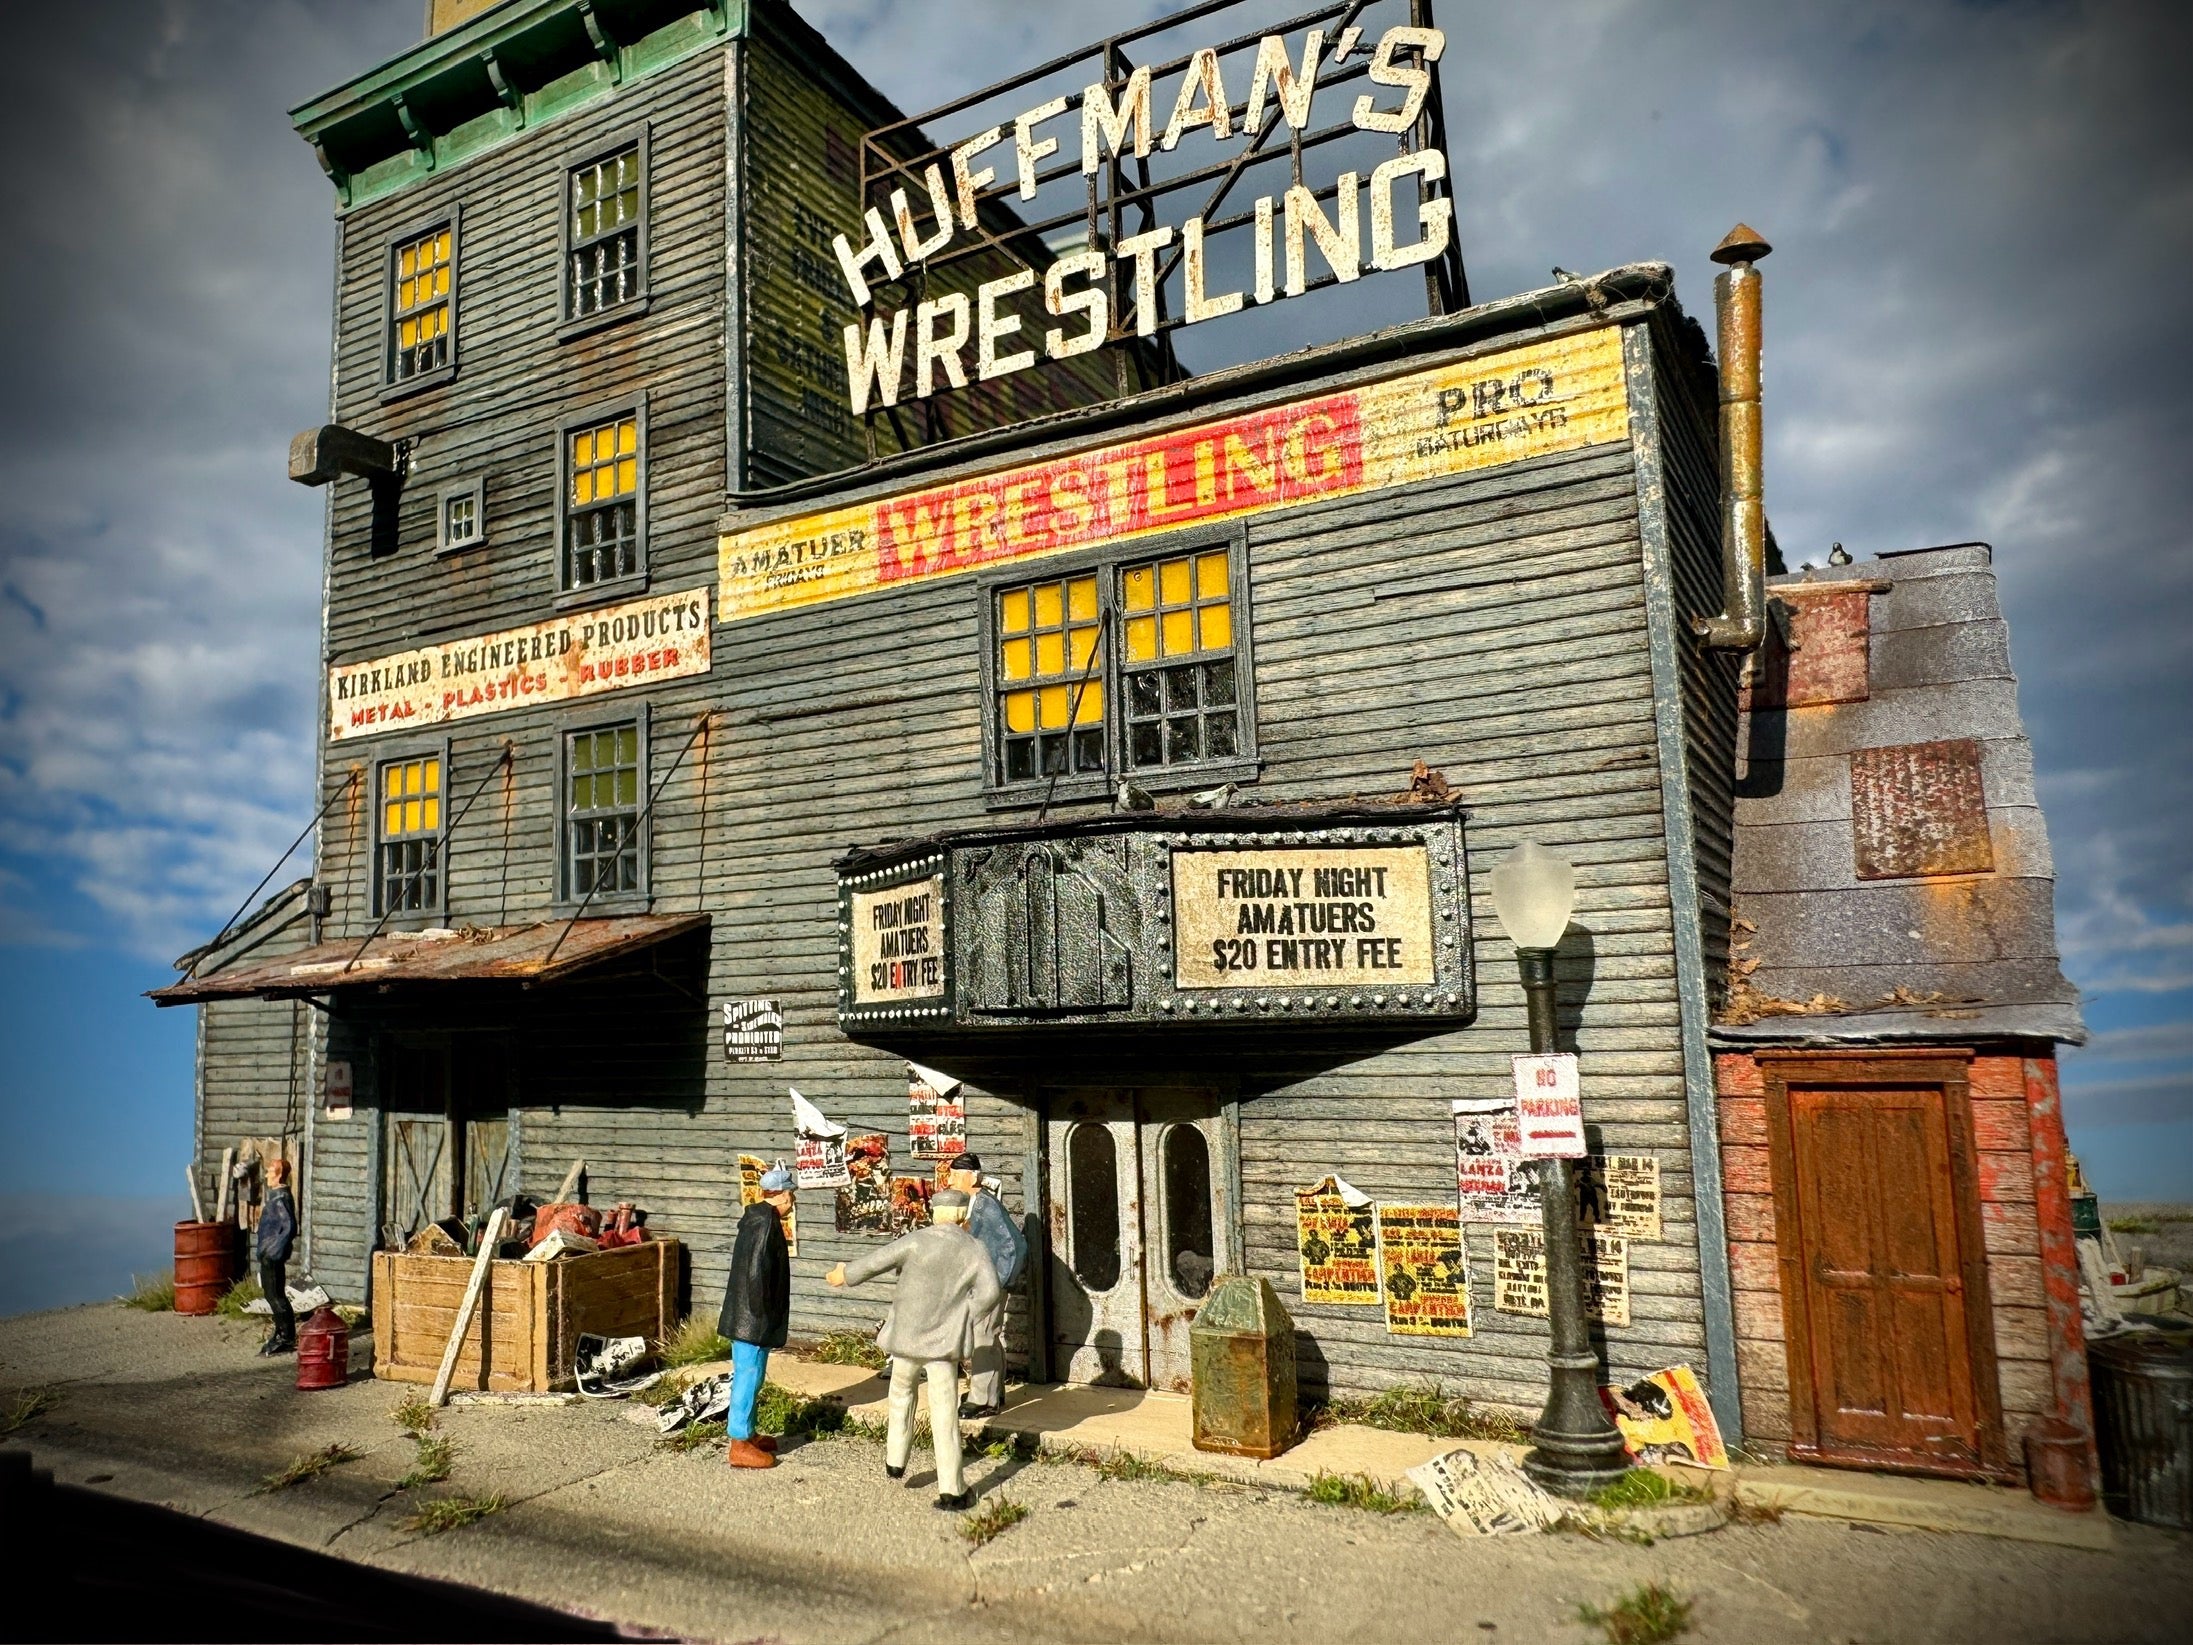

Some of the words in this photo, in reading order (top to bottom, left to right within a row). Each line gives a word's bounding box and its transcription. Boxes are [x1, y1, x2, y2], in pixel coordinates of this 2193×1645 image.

[832, 26, 1446, 307] HUFFMAN'S
[843, 148, 1452, 416] WRESTLING
[1436, 368, 1553, 429] PRO
[889, 414, 1343, 570] WRESTLING
[731, 528, 866, 579] AMATUER
[337, 660, 431, 701] KIRKLAND
[441, 629, 571, 679] ENGINEERED
[582, 600, 701, 650] PRODUCTS
[351, 700, 415, 727] METAL
[443, 673, 547, 710] PLASTICS
[579, 648, 680, 683] RUBBER
[1217, 868, 1303, 898] FRIDAY
[1314, 867, 1388, 898] NIGHT
[873, 901, 903, 931] FRIDAY
[904, 893, 930, 925] NIGHT
[1237, 902, 1376, 935] AMATUERS
[881, 926, 929, 960] AMATUERS
[1212, 939, 1257, 973] $20
[1266, 938, 1346, 970] ENTRY
[1357, 938, 1403, 969] FEE
[871, 962, 888, 992] $20
[890, 959, 919, 989] ENTRY
[922, 956, 938, 986] FEE
[724, 1000, 772, 1025] SPITTING
[726, 1031, 780, 1045] PROHIBITED
[1536, 1068, 1557, 1087] NO
[1521, 1098, 1579, 1117] PARKING
[1460, 1163, 1504, 1177] LANZA
